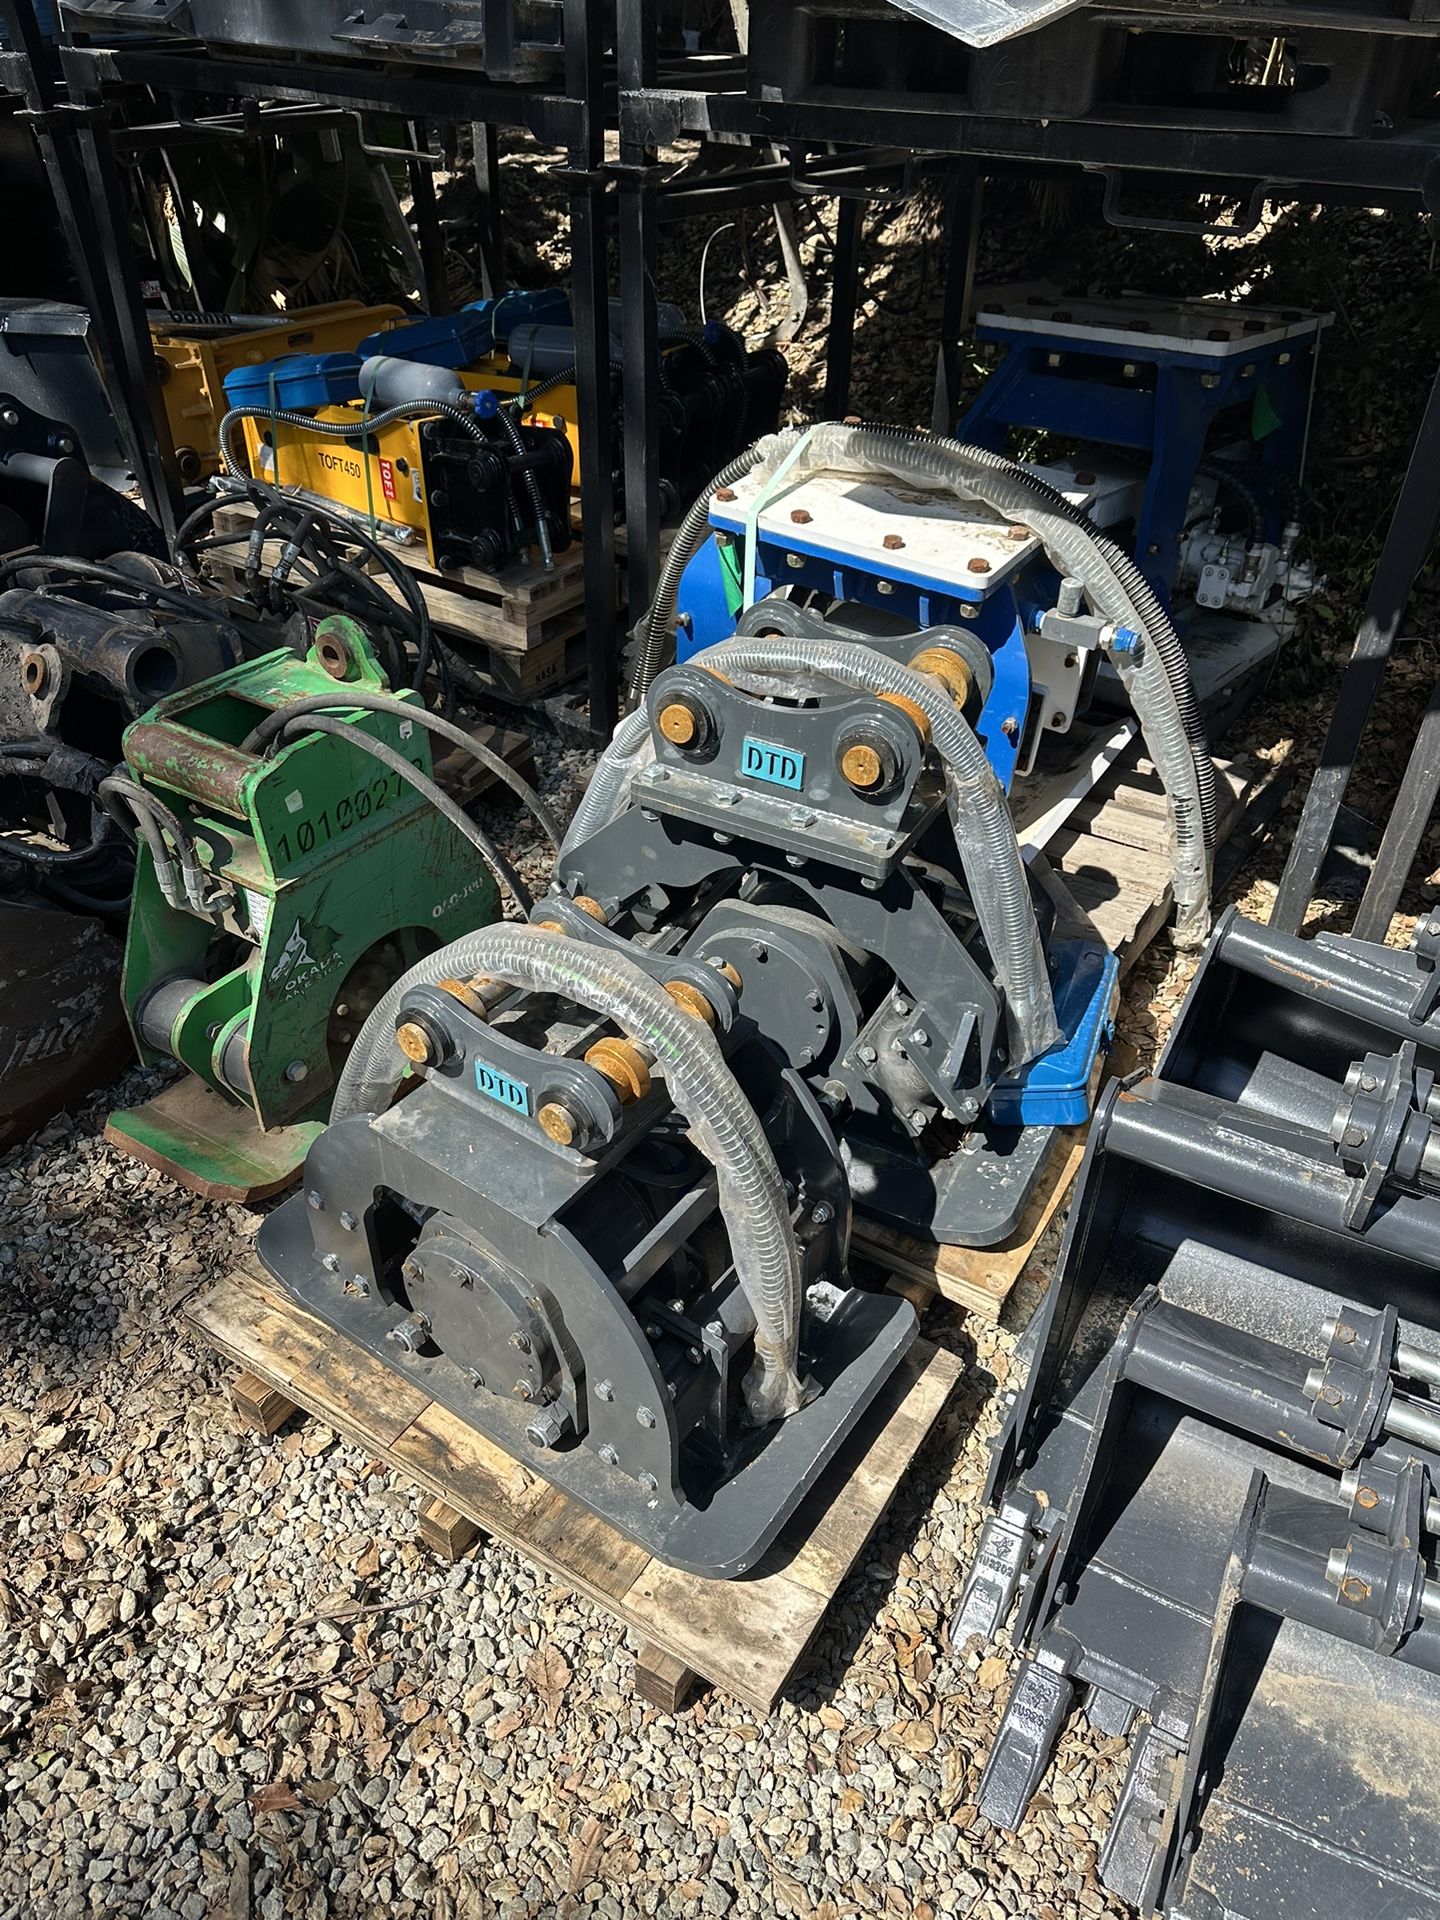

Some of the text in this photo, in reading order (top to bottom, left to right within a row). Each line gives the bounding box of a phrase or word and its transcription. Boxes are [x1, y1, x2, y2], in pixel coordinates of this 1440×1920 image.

[318, 452, 361, 478] TOFT450
[381, 461, 395, 499] TOFT
[747, 746, 797, 780] DTD
[480, 1067, 523, 1105] DTD
